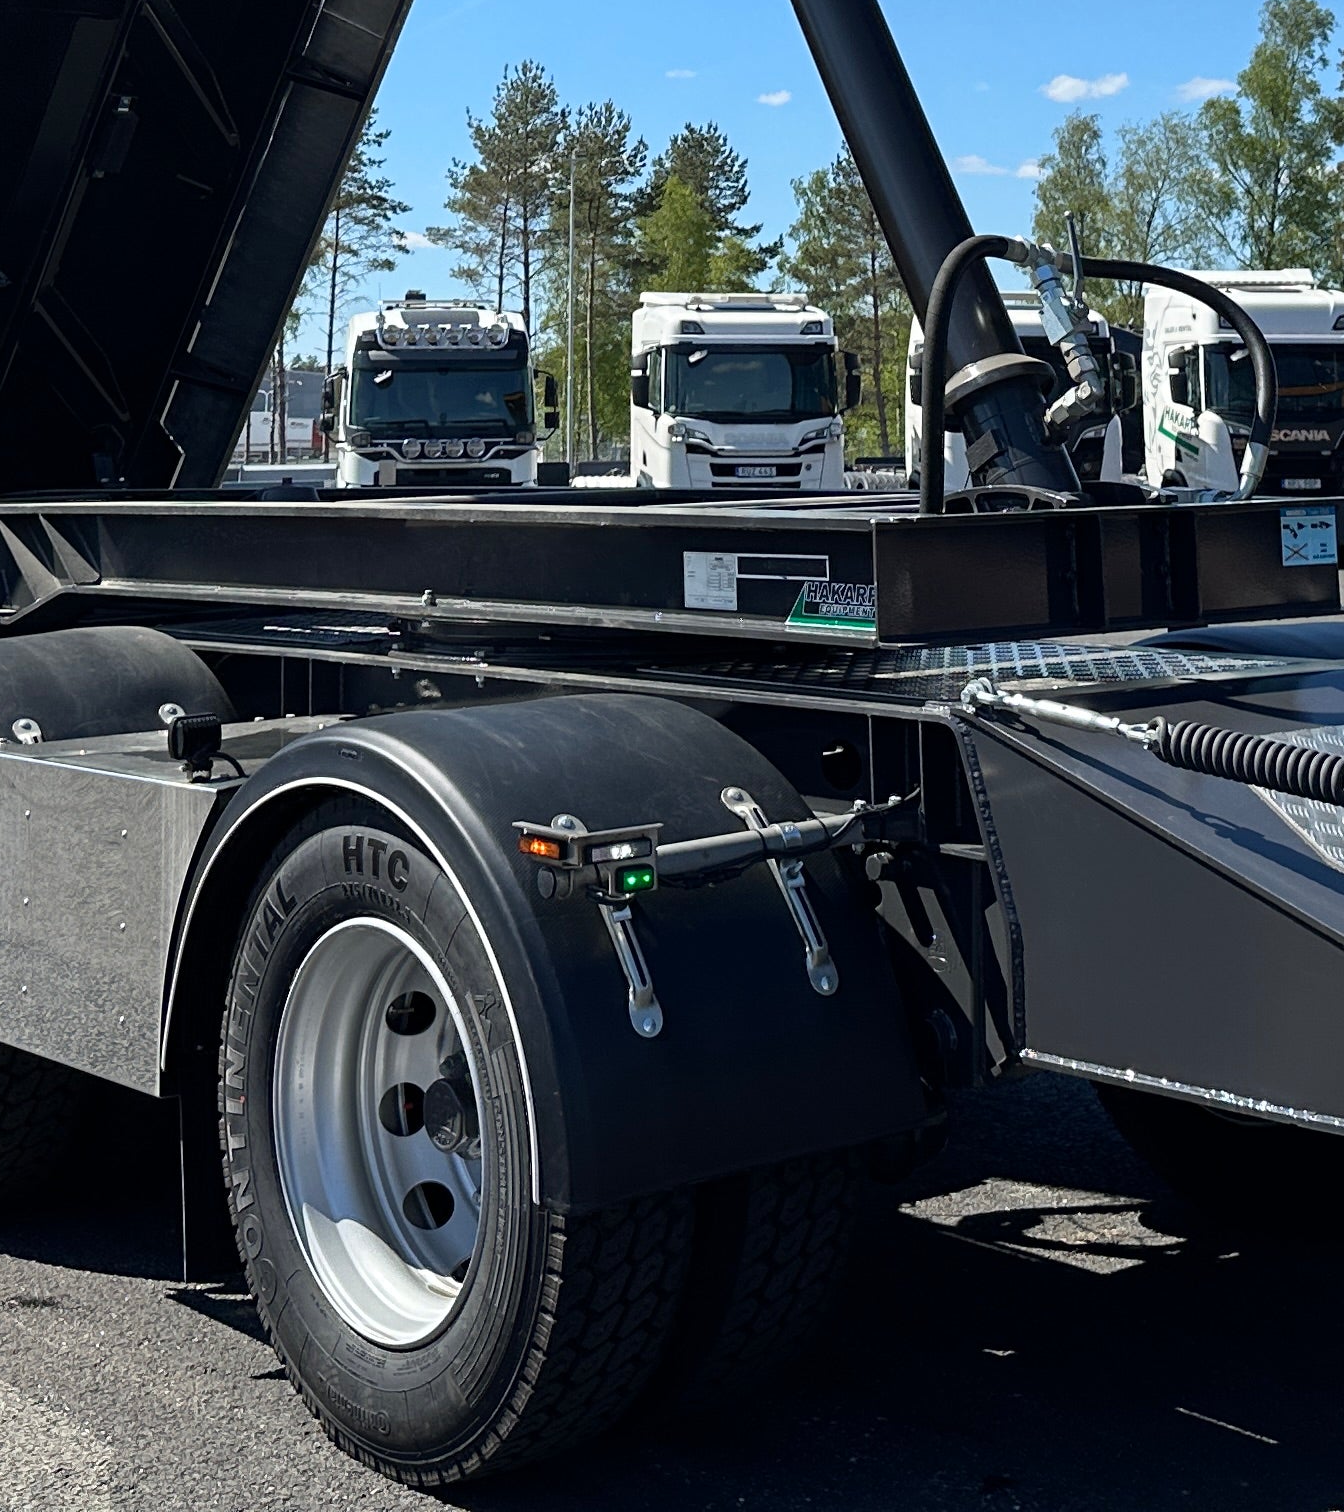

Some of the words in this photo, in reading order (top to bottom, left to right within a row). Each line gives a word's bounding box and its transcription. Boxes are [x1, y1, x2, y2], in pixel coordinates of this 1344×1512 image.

[1271, 429, 1330, 442] SCANIA
[819, 603, 876, 618] EQUIPMENT
[342, 834, 410, 893] HTC
[224, 877, 299, 1305] CONTINENTAL
